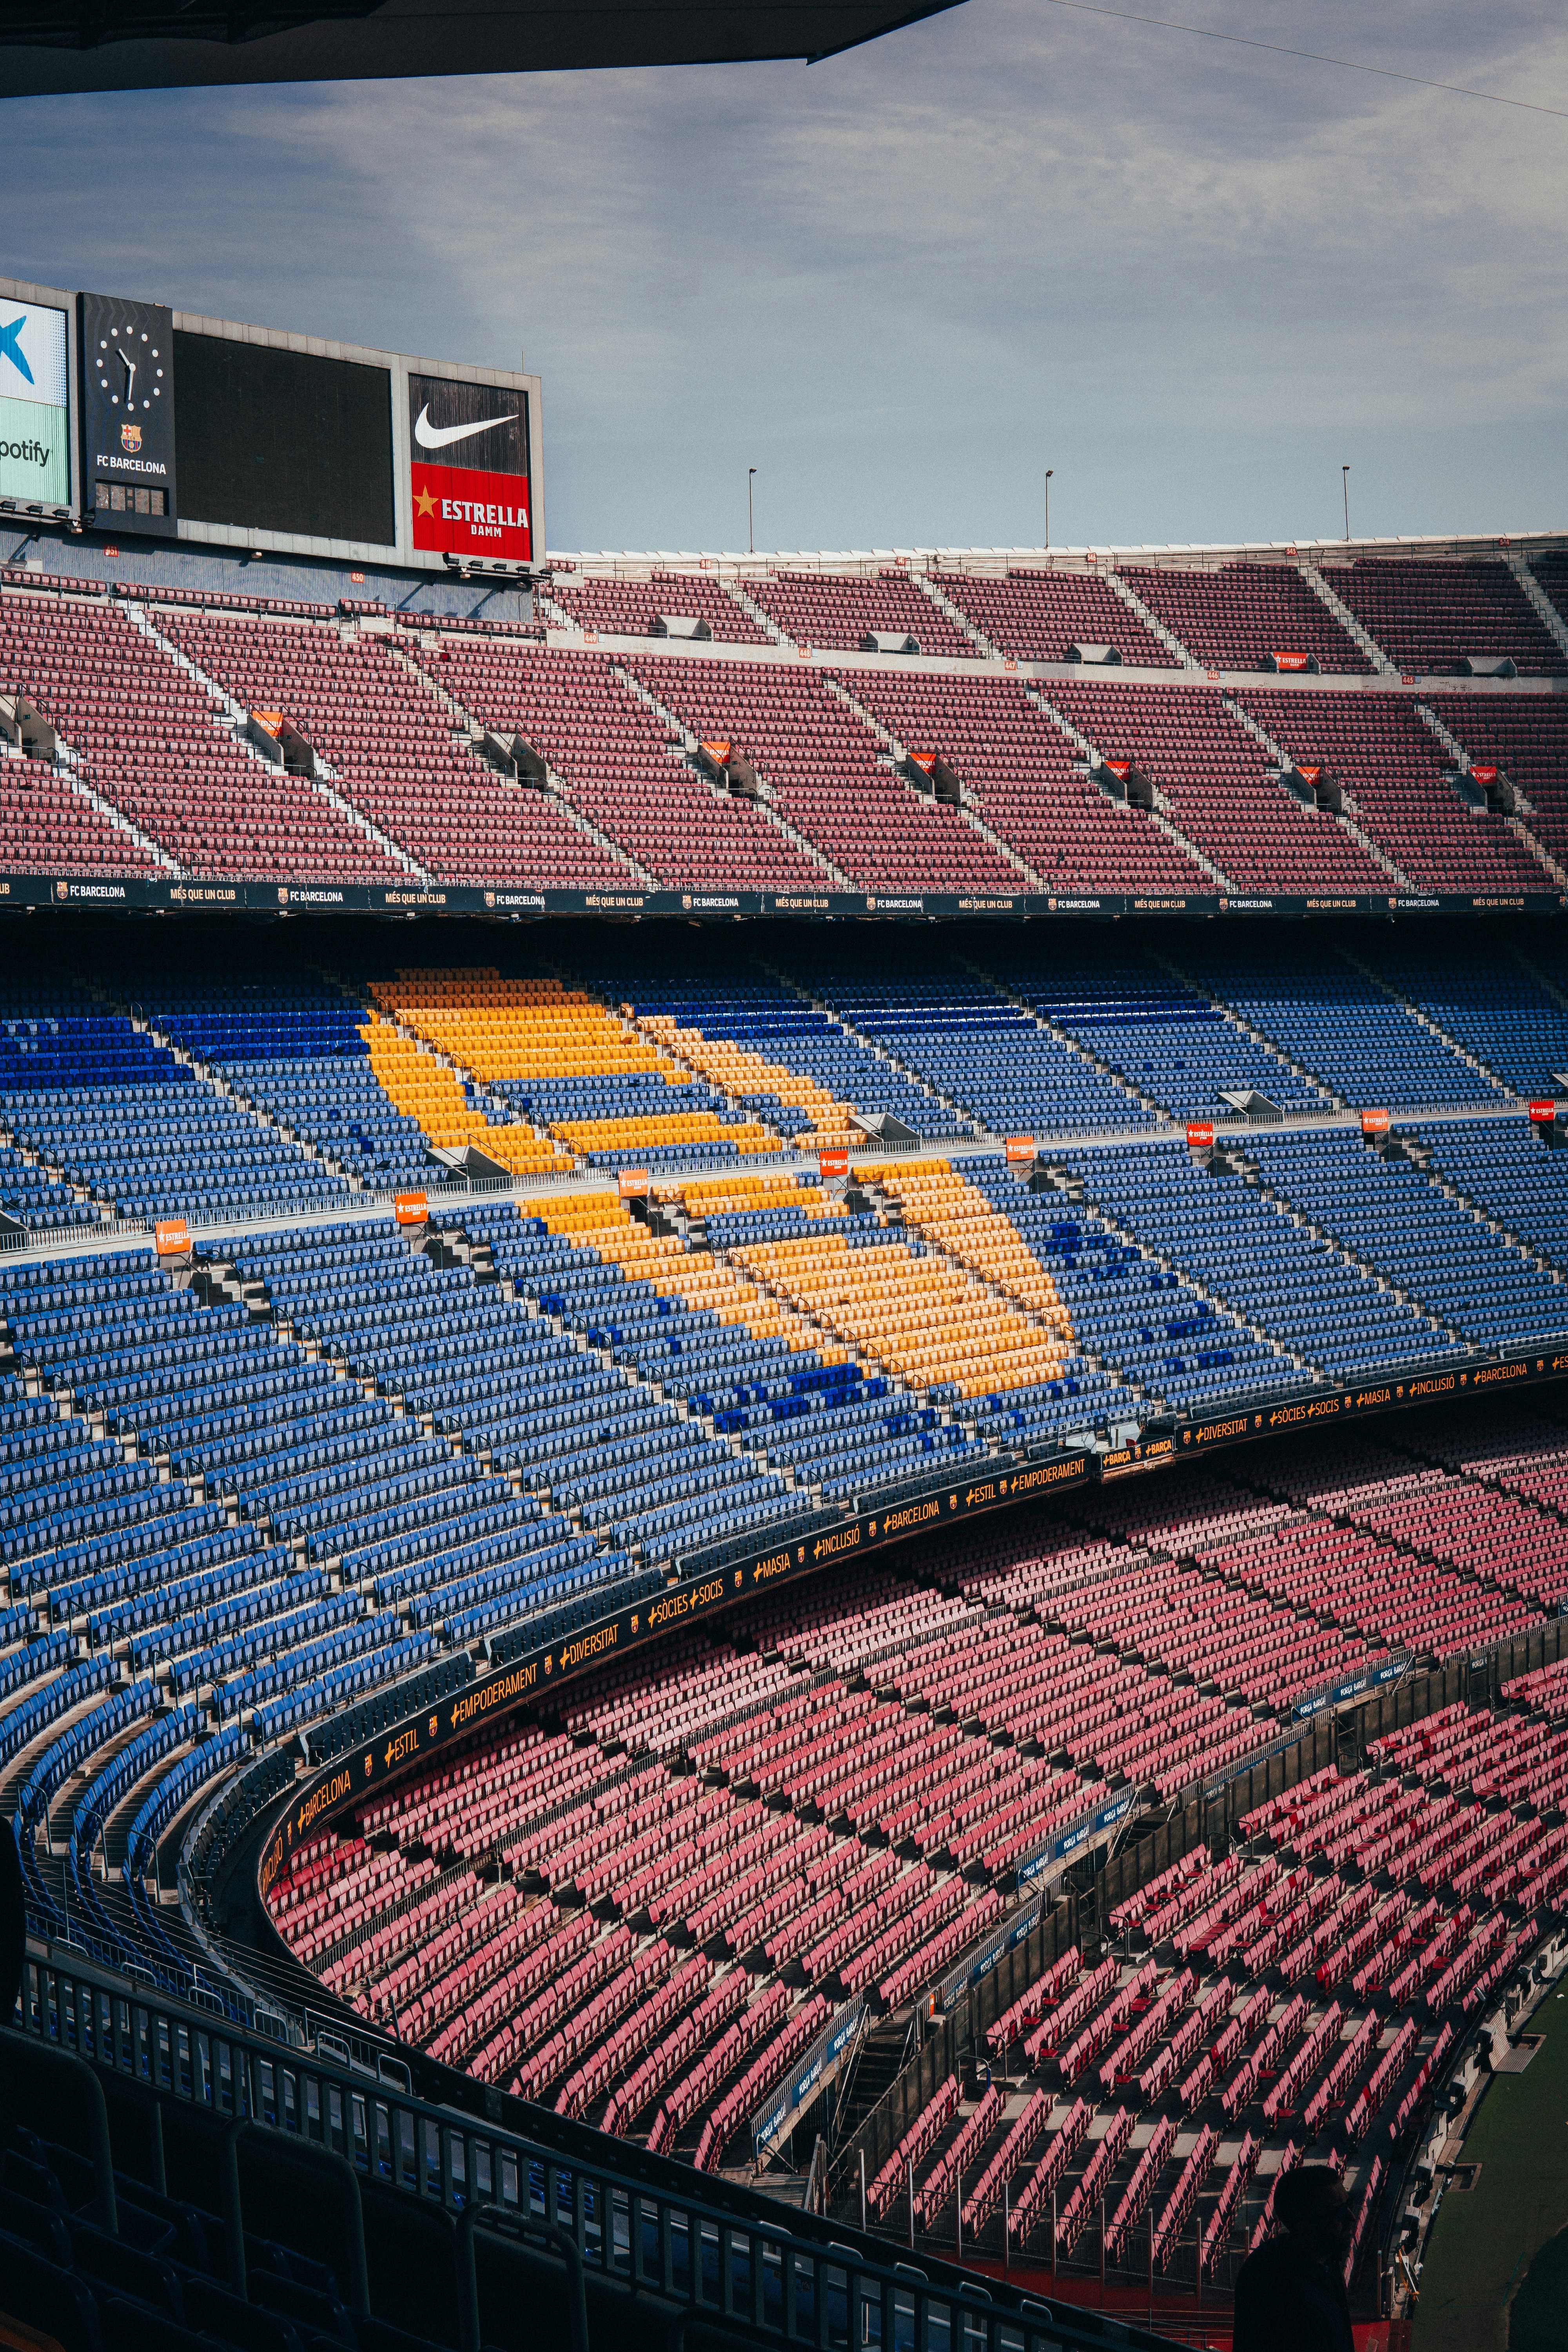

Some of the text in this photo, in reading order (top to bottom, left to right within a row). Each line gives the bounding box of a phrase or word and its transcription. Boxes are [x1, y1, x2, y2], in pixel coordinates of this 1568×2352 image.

[97, 455, 166, 475] FC BARCELONA
[441, 499, 528, 528] ESTRELLA
[471, 524, 502, 537] DAMM
[352, 573, 363, 582] 450
[584, 634, 596, 643] 449
[800, 649, 810, 657] 448
[71, 886, 125, 897] FC BARCELONA
[171, 886, 236, 901] MÉS QUE UN CLUB
[290, 891, 343, 902] FC BARCELONA
[385, 891, 446, 905] MÉS QUE UN CLUB
[496, 895, 545, 905] FC BARCELONA
[586, 894, 643, 907] MÉS QUE UN CLUB
[693, 898, 739, 906] FC BARCELONA
[776, 896, 789, 907] MÉS
[790, 898, 802, 909] QUE
[803, 899, 812, 907] UN
[959, 898, 972, 908] MÉS
[974, 900, 986, 909] QUE
[1134, 898, 1147, 908] MÉS
[1148, 900, 1160, 909] QUE
[1307, 898, 1319, 907] MÉS
[1320, 900, 1332, 909] QUE
[877, 900, 885, 908] FC
[405, 1203, 427, 1212] ESTRELLA
[166, 1231, 190, 1242] ESTRELLA
[1381, 1668, 1392, 1679] FORÇA
[1341, 1685, 1352, 1696] FORÇA
[1300, 1703, 1312, 1715] FORÇA
[1104, 1809, 1116, 1823] FORÇA
[1063, 1835, 1075, 1849] FORÇA
[1016, 1924, 1027, 1940] FORÇA
[981, 1956, 992, 1974] FORÇA
[834, 2031, 846, 2051] FORÇA
[799, 2074, 810, 2095] FORÇA
